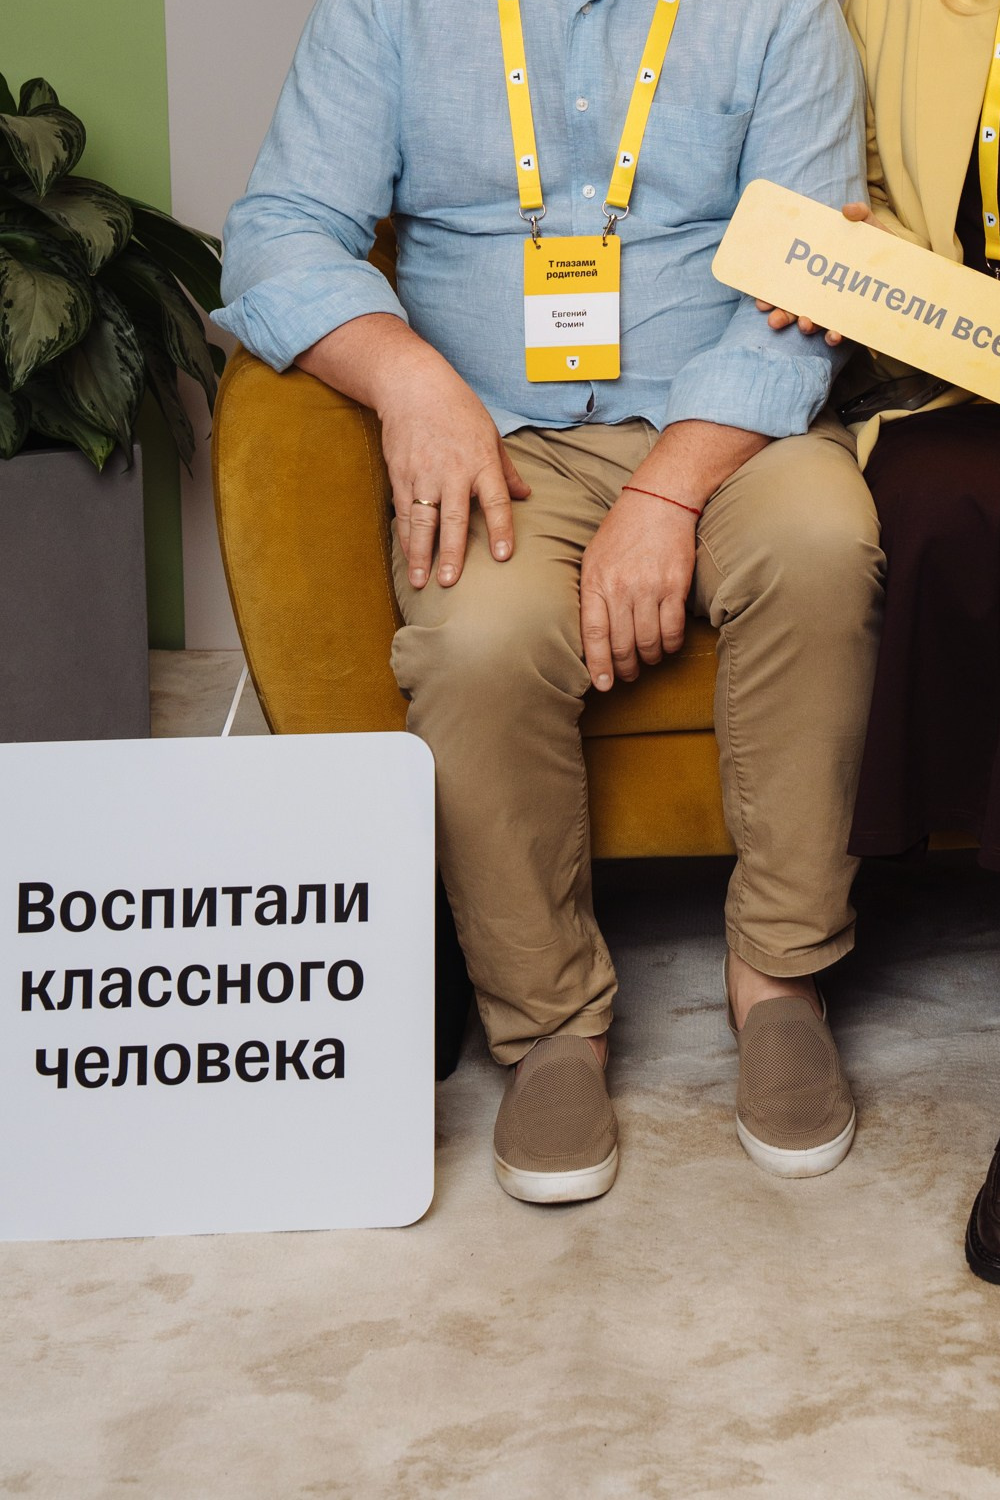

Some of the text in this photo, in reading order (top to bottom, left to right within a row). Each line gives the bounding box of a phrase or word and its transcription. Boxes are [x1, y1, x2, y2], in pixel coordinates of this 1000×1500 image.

[546, 268, 598, 280] родителей
[548, 259, 596, 268] Т глазами
[784, 238, 948, 330] Родители
[551, 309, 587, 319] Евгений
[554, 321, 585, 329] Фомин
[17, 881, 369, 934] Воспитали
[20, 959, 365, 1012] классного
[35, 1037, 346, 1089] человека
